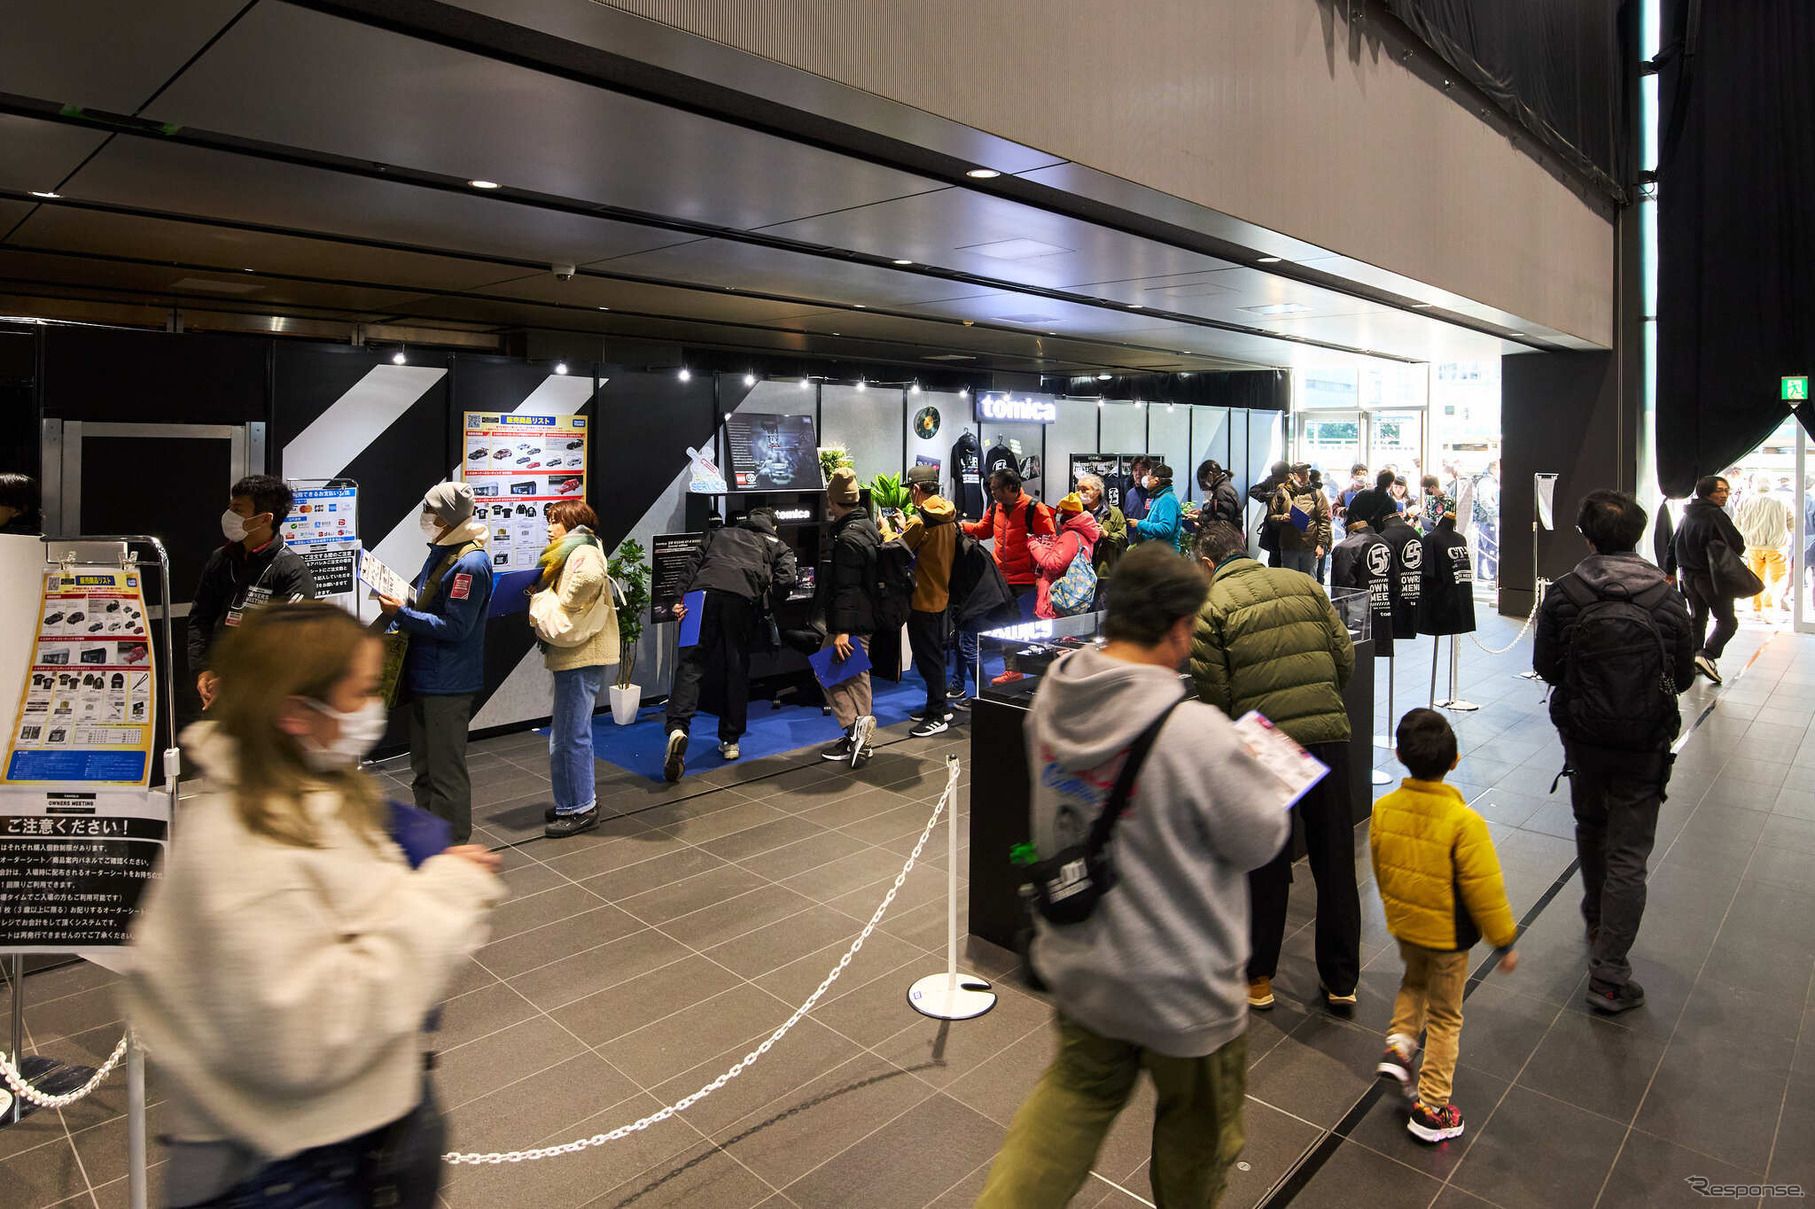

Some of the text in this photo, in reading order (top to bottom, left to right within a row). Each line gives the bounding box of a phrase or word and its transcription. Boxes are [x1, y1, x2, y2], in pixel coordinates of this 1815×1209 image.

[981, 394, 1056, 421] tomica
[775, 508, 811, 520] tomica
[7, 818, 129, 836] ご注意ください！
